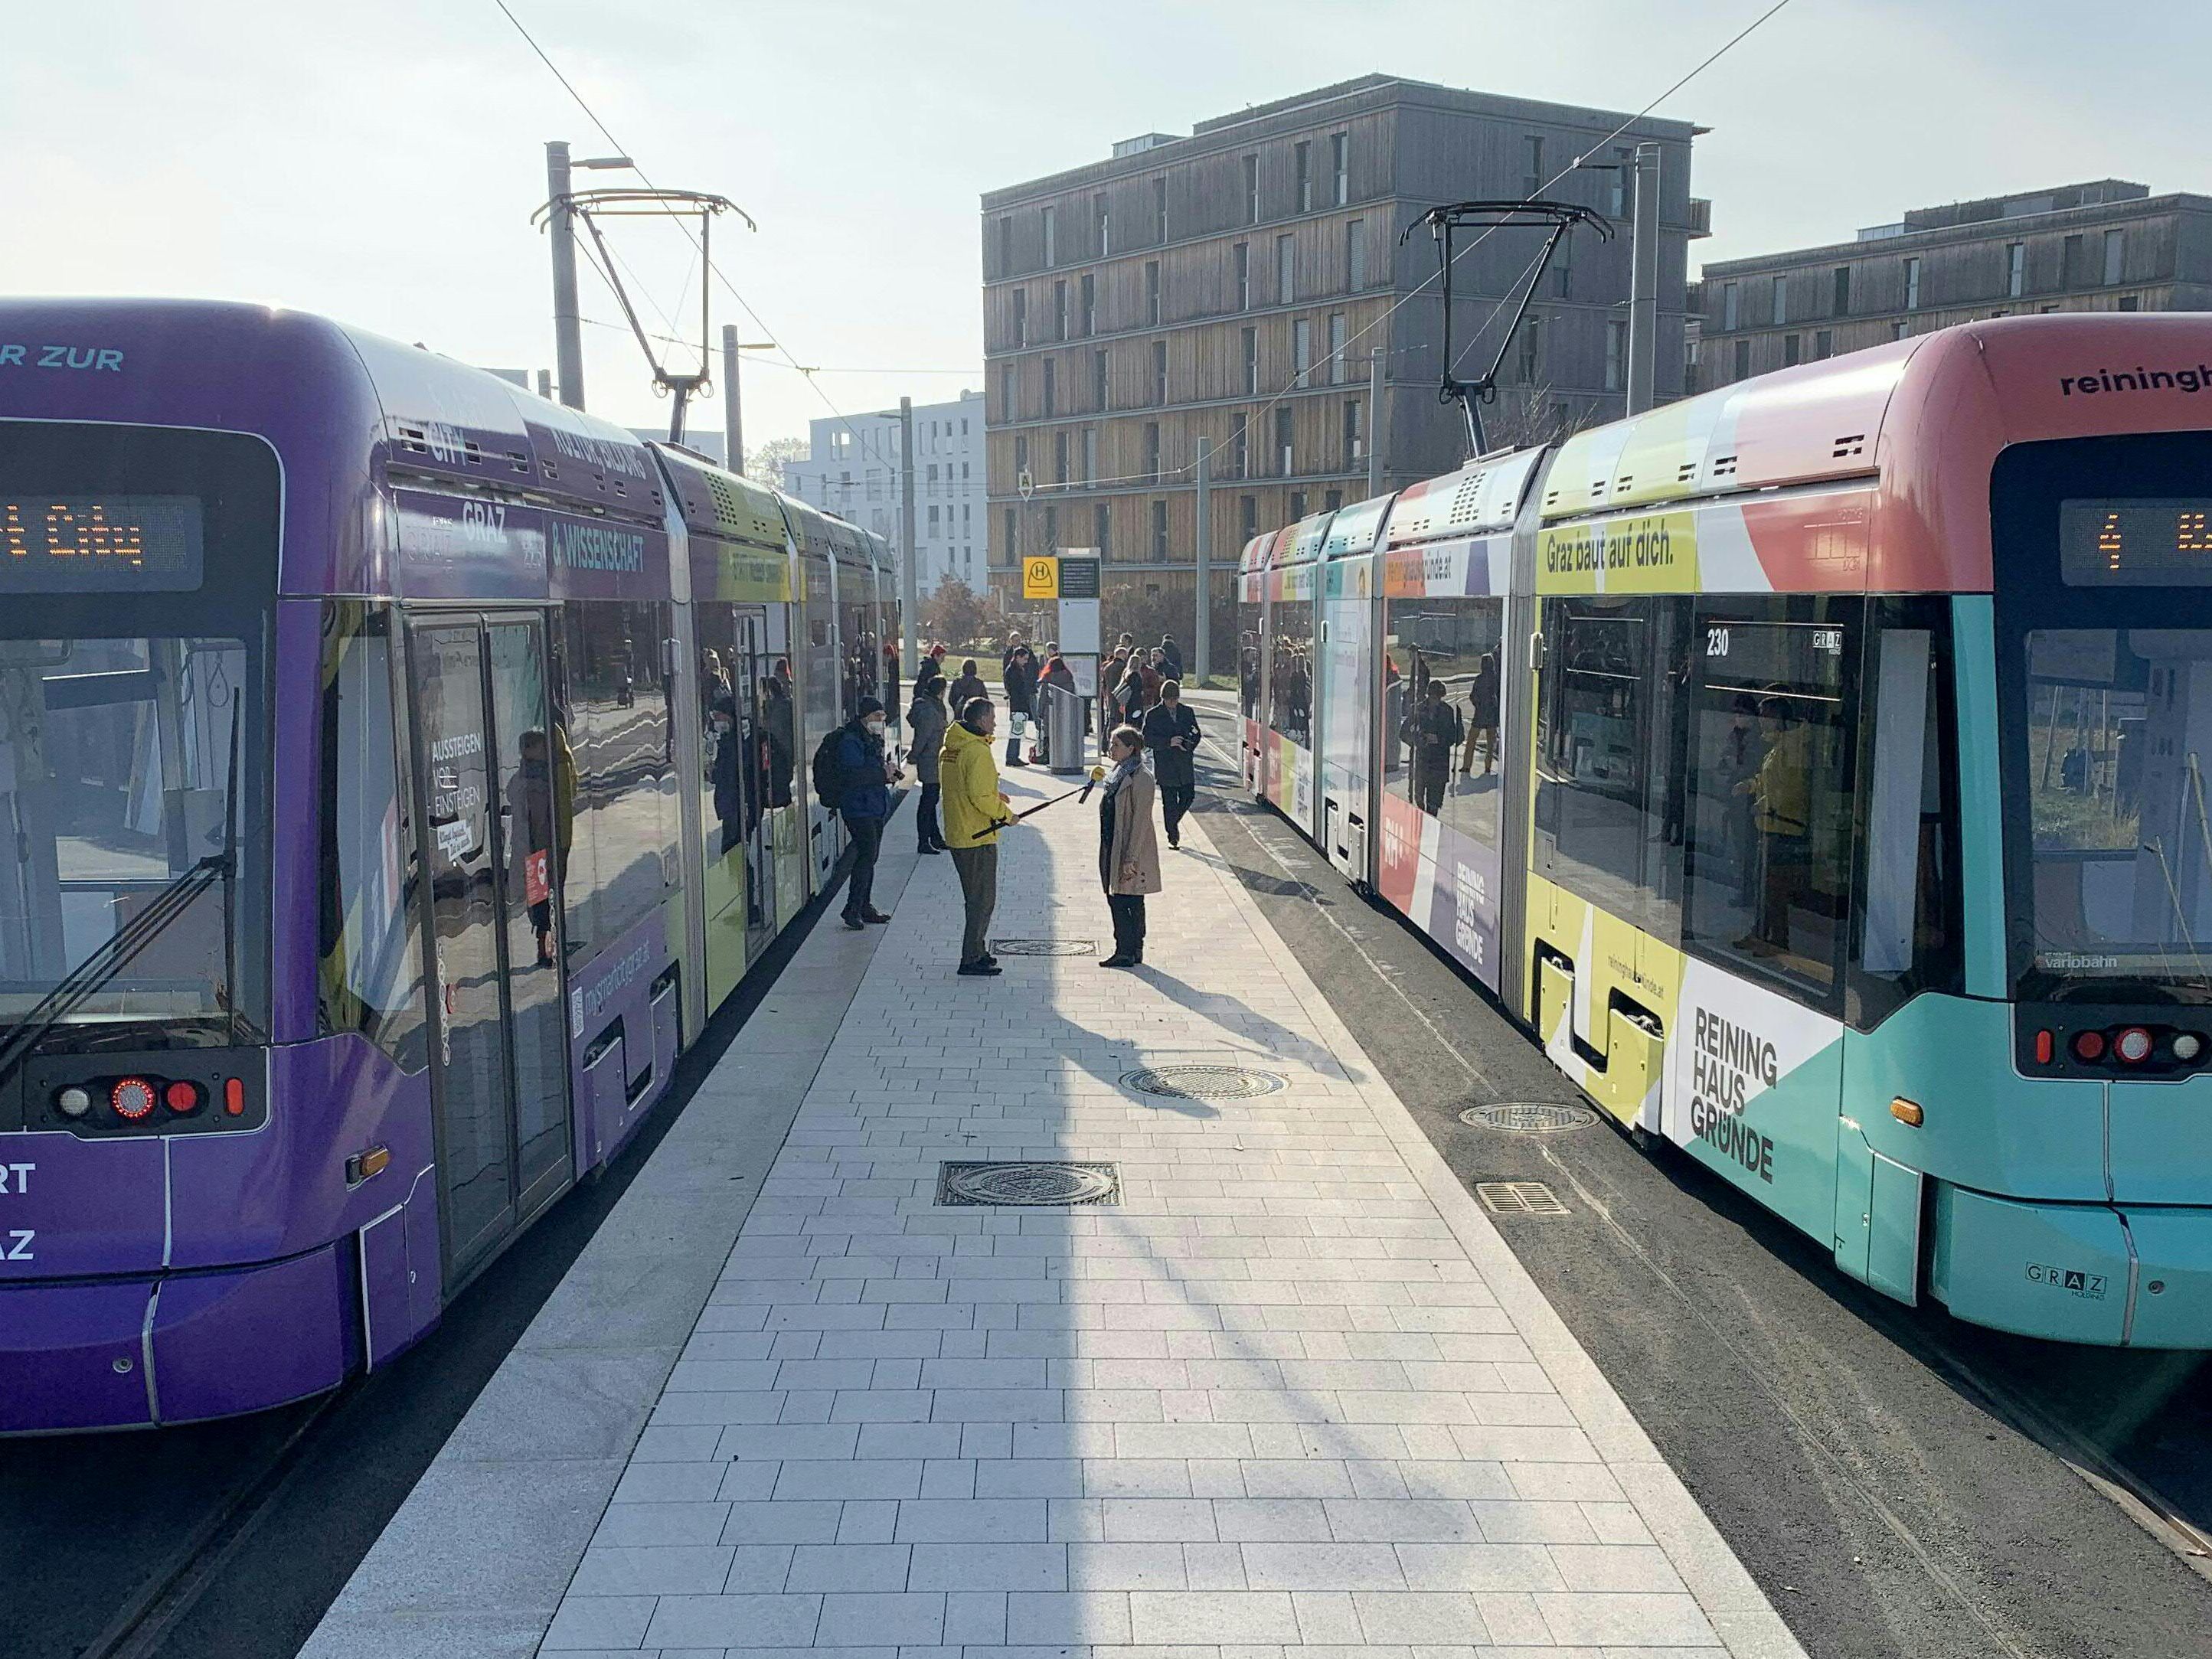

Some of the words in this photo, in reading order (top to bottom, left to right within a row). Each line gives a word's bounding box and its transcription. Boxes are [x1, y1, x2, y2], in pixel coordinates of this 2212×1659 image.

[37, 345, 125, 372] ZUR
[462, 501, 508, 544] GRAZ
[551, 521, 562, 567] &
[564, 522, 644, 573] WISSENSCHAFT
[1547, 534, 1573, 573] Graz
[1576, 531, 1605, 571] baut
[1609, 522, 1632, 569] auf
[1635, 518, 1674, 567] dich.
[1035, 564, 1044, 577] H
[1707, 628, 1729, 656] 230
[1813, 631, 1842, 648] GRAZ
[432, 732, 482, 763] AUSSTEIGEN
[433, 766, 452, 789] VOR
[434, 784, 481, 818] EINSTEIGEN
[2044, 955, 2118, 968] variobahn
[1695, 1006, 1778, 1090] REINING
[1693, 1050, 1745, 1117] HAUS
[1691, 1096, 1774, 1185] GRÜNDE
[0, 1164, 36, 1194] T
[0, 1230, 35, 1260] Z
[2027, 1265, 2103, 1292] GRAZ
